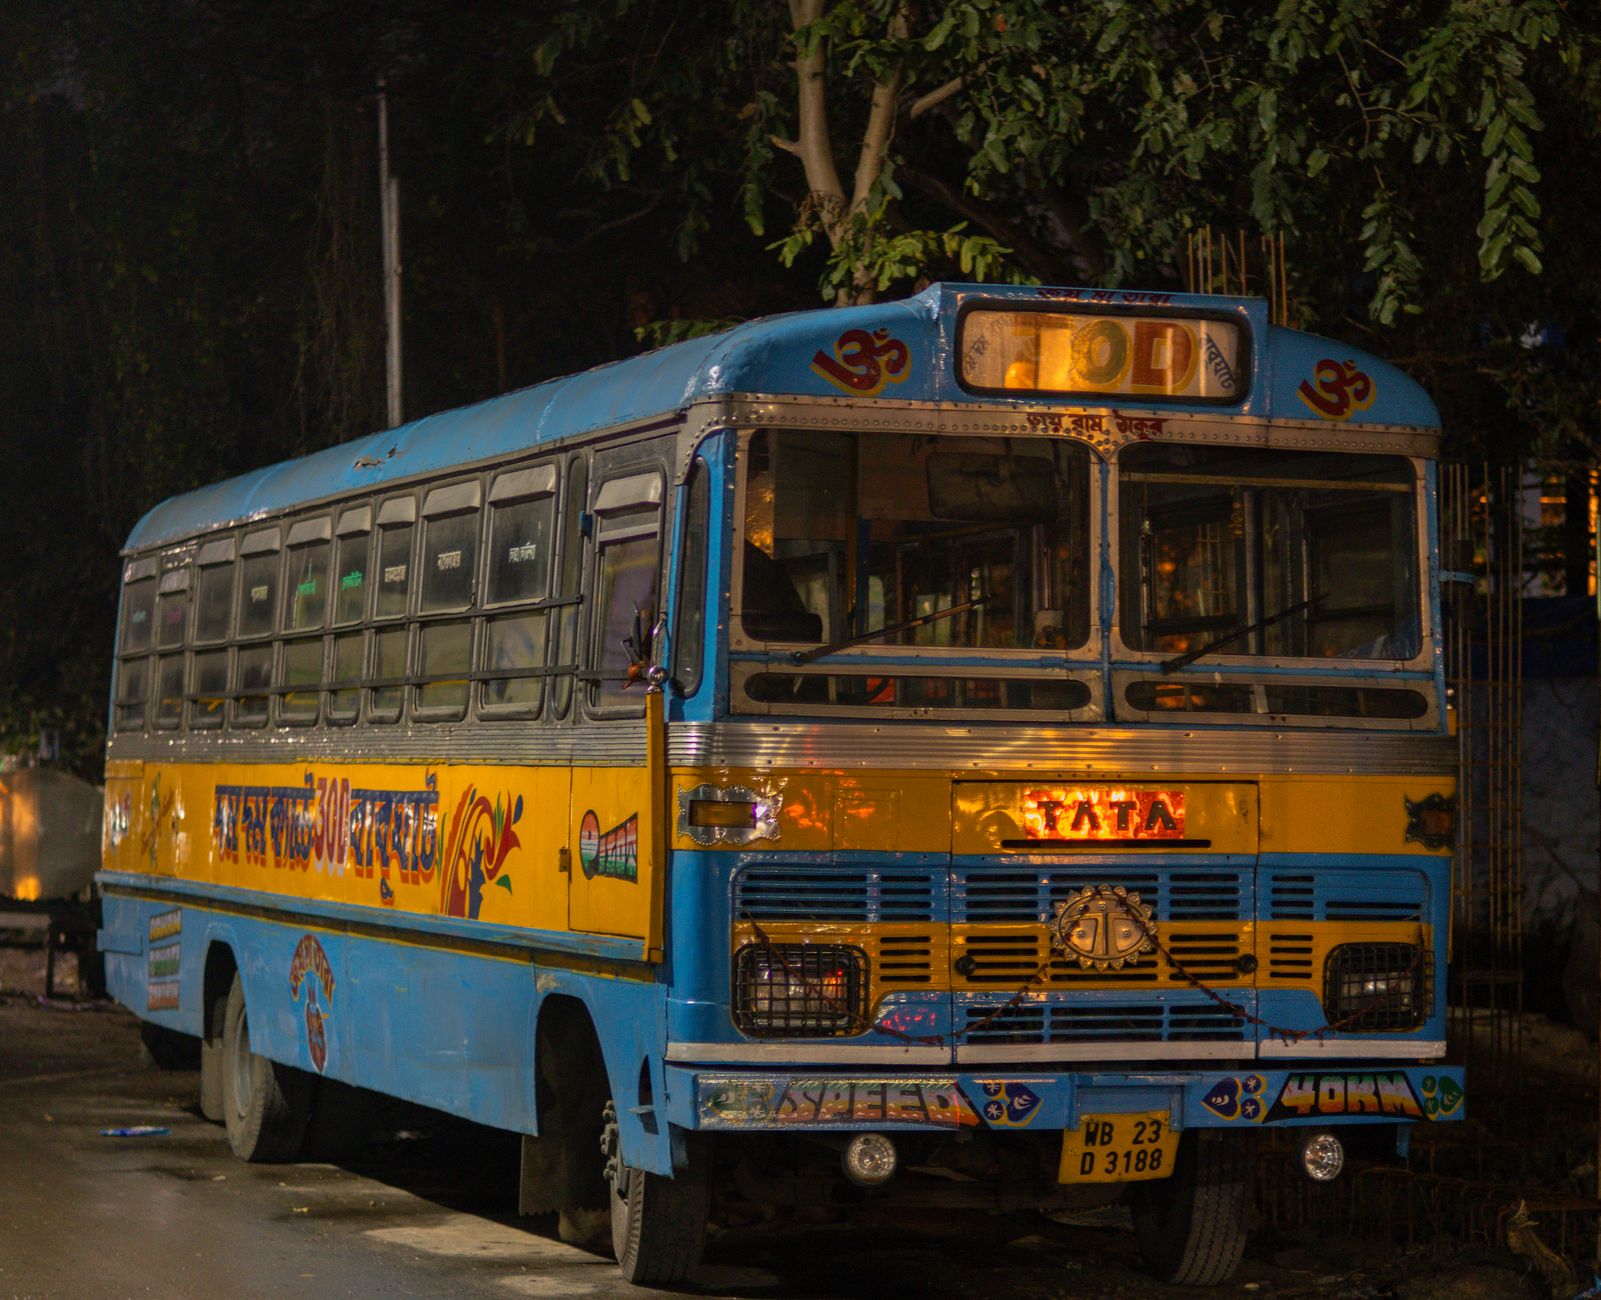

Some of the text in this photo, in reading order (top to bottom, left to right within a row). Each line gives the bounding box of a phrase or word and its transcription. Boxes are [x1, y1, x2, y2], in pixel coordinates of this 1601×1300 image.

[1037, 800, 1177, 832] TATA
[776, 1081, 984, 1126] SPEED
[1085, 1119, 1162, 1147] WB 23
[1080, 1147, 1163, 1176] D 3188
